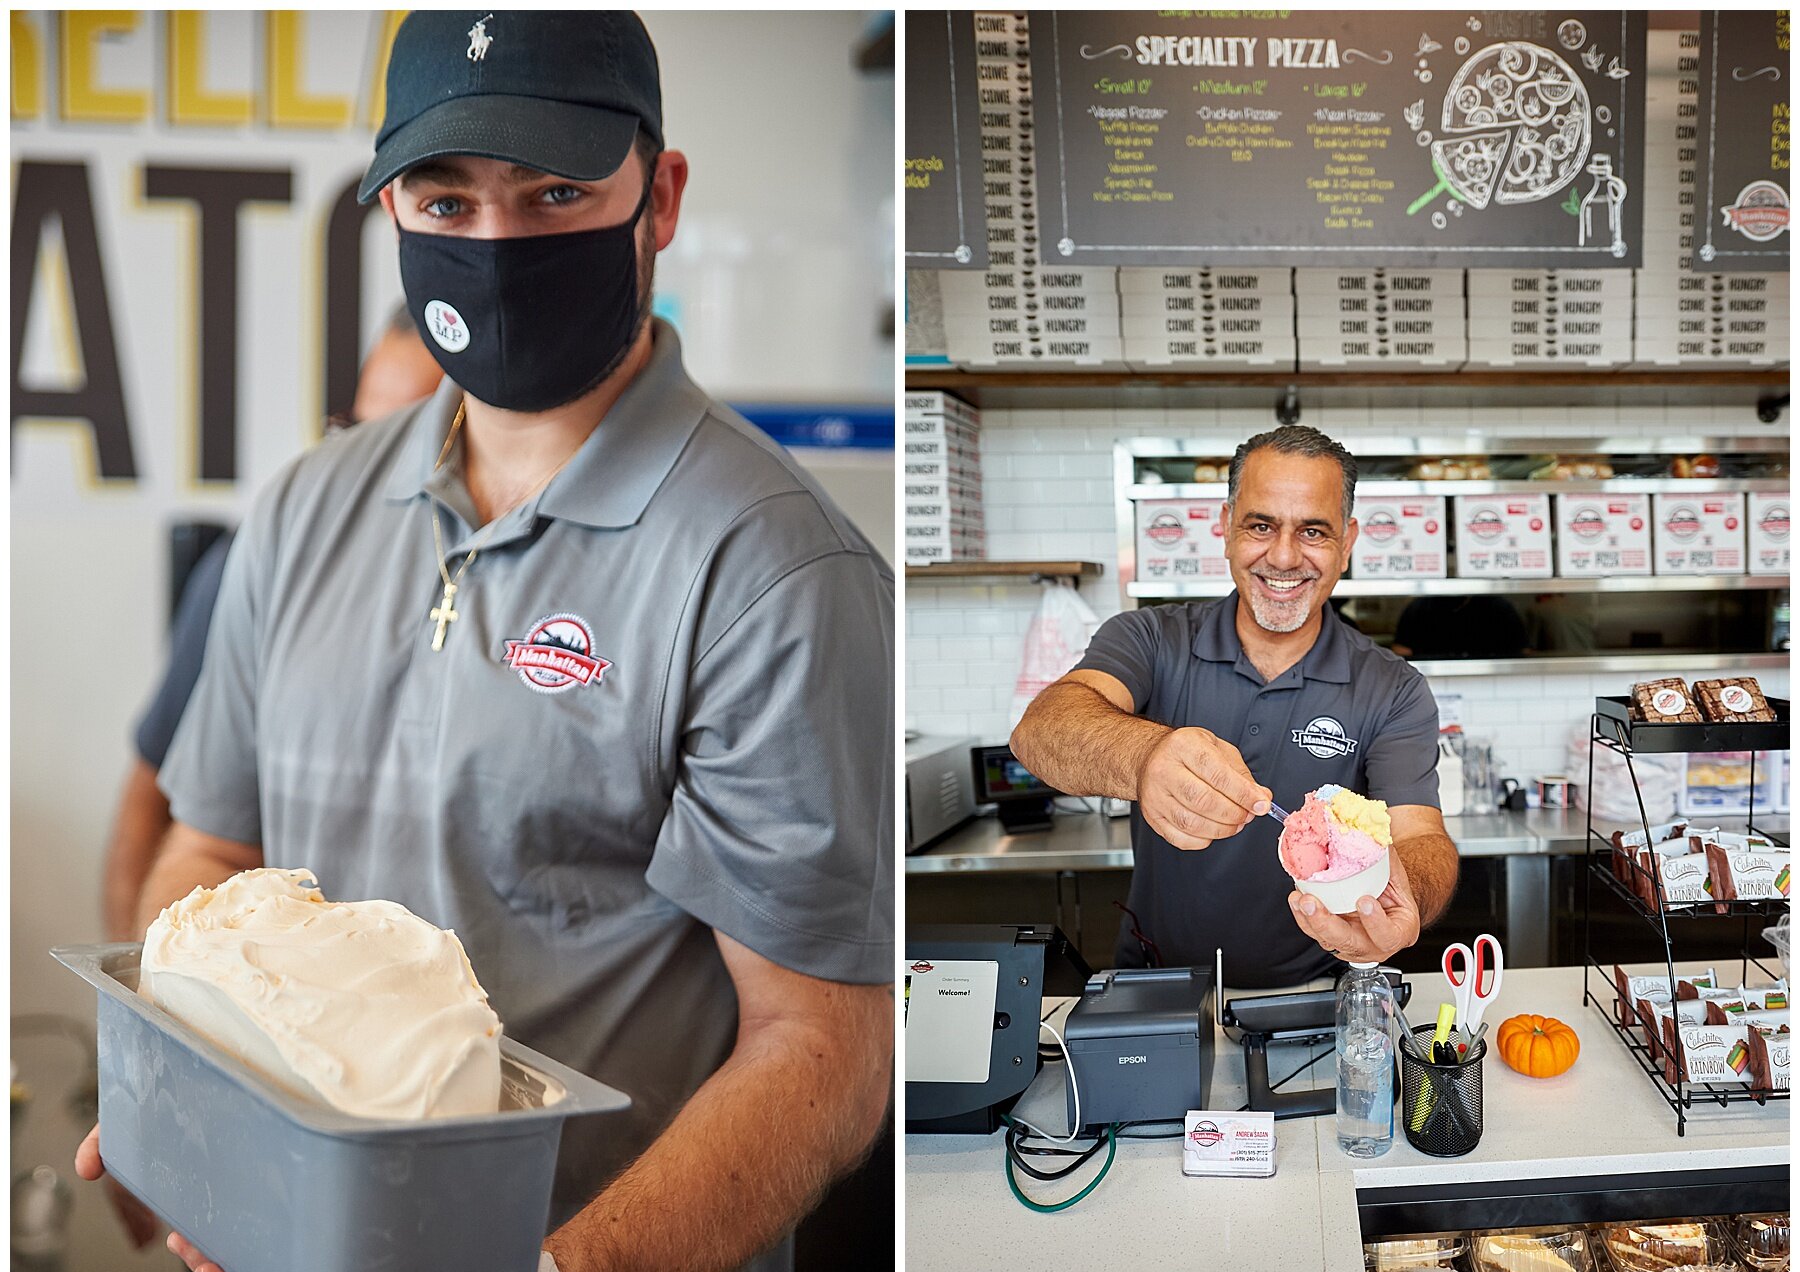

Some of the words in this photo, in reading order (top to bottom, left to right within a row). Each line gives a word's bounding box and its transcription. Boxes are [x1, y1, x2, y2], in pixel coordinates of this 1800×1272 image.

[1135, 35, 1258, 67] SPECIALTY
[1267, 37, 1341, 68] PIZZA
[985, 273, 1015, 288] COME
[1041, 273, 1082, 288] HUNGRY
[1163, 275, 1192, 288] COME
[1217, 275, 1258, 289] HUNGRY
[1679, 278, 1705, 291] COME
[1729, 278, 1767, 292] HUNGRY
[988, 296, 1017, 310] COME
[1043, 296, 1085, 310] HUNGRY
[1166, 297, 1194, 311] COME
[1221, 297, 1261, 311] HUNGRY
[1679, 299, 1705, 312] COME
[1729, 299, 1767, 312] HUNGRY
[989, 319, 1019, 333] COME
[1045, 319, 1086, 332] HUNGRY
[1166, 319, 1195, 332] COME
[1221, 319, 1261, 332] HUNGRY
[1679, 320, 1705, 333] COME
[1729, 320, 1766, 334] HUNGRY
[993, 342, 1022, 355] COME
[1048, 342, 1089, 355] HUNGRY
[1168, 342, 1197, 355] COME
[1222, 342, 1263, 355] HUNGRY
[1678, 342, 1704, 355] COME
[1728, 342, 1765, 355] HUNGRY
[516, 648, 589, 681] Manhattan
[1302, 735, 1345, 752] Manhattan
[1738, 883, 1773, 896] RAINBOW
[1686, 1032, 1724, 1050] Cakebites
[1118, 1055, 1147, 1066] EPSON
[1690, 1060, 1725, 1075] RAINBOW
